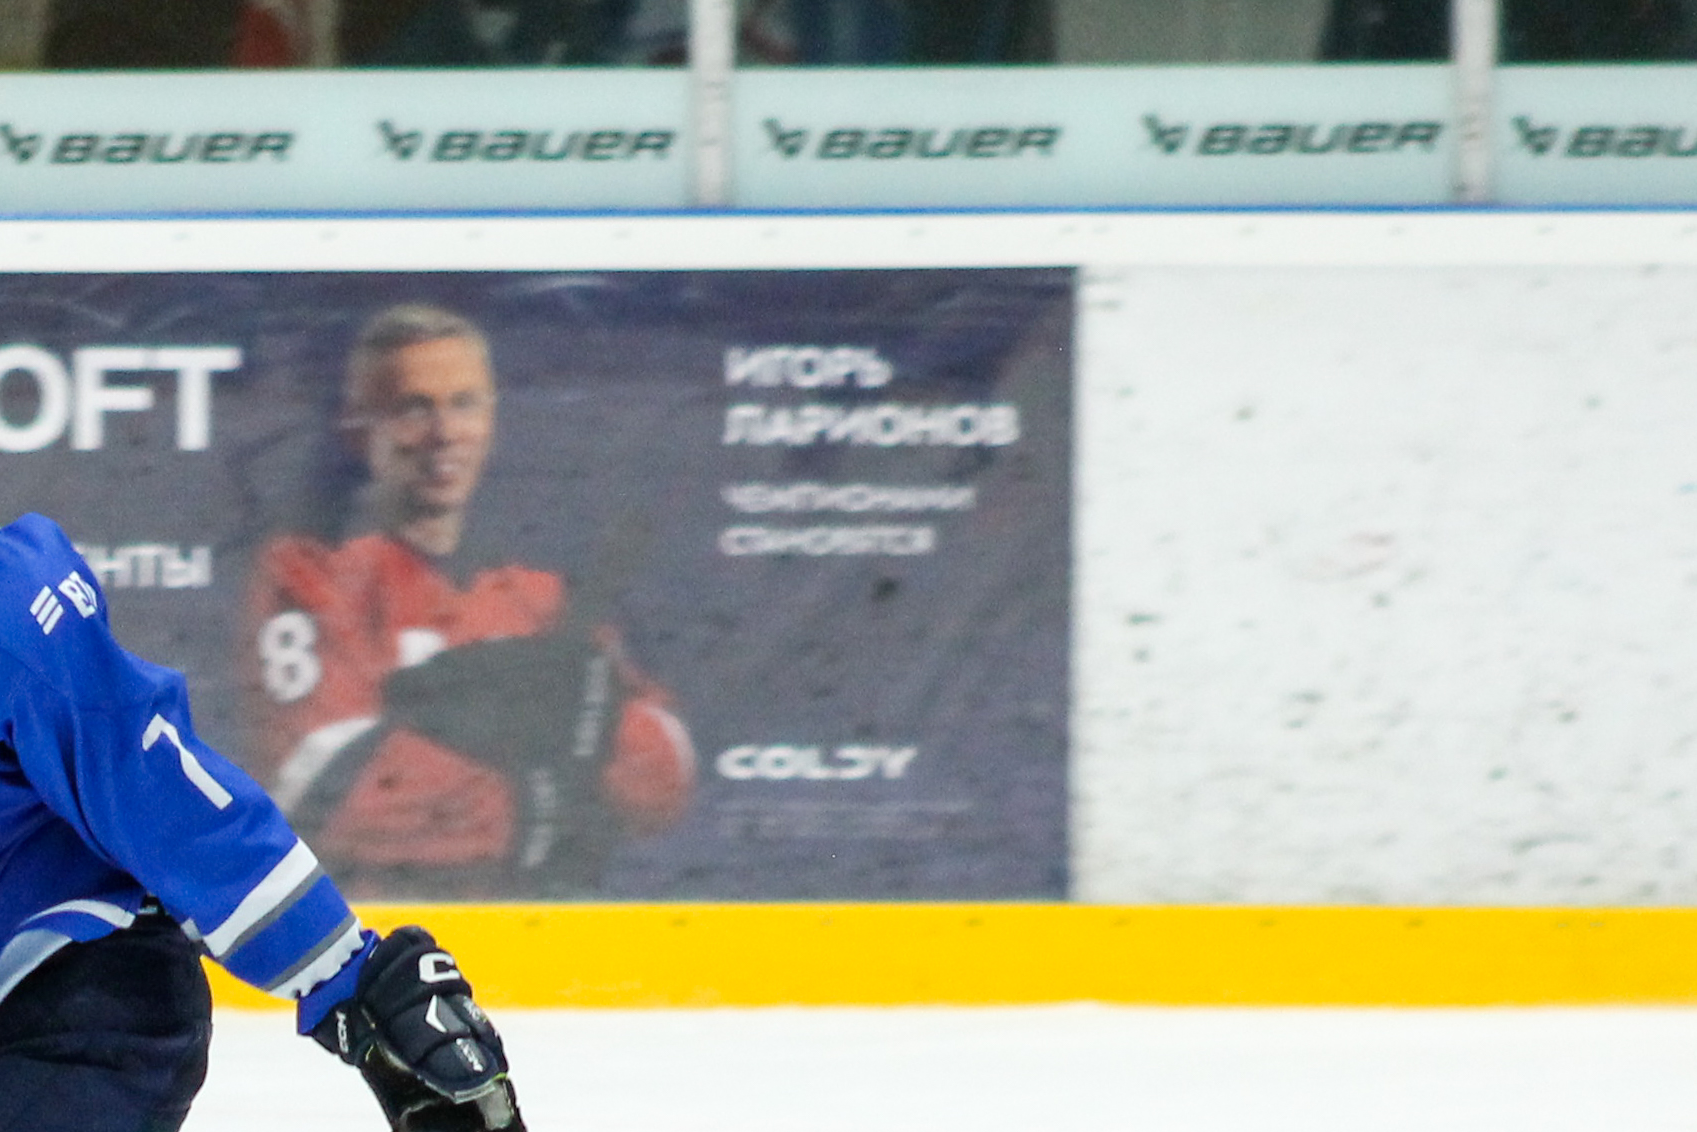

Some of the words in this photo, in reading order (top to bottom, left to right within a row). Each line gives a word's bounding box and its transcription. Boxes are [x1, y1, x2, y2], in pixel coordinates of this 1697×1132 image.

[724, 345, 893, 388] ИГОРЬ
[723, 404, 1019, 446] ЛАРИОНОВ
[259, 611, 322, 702] 8
